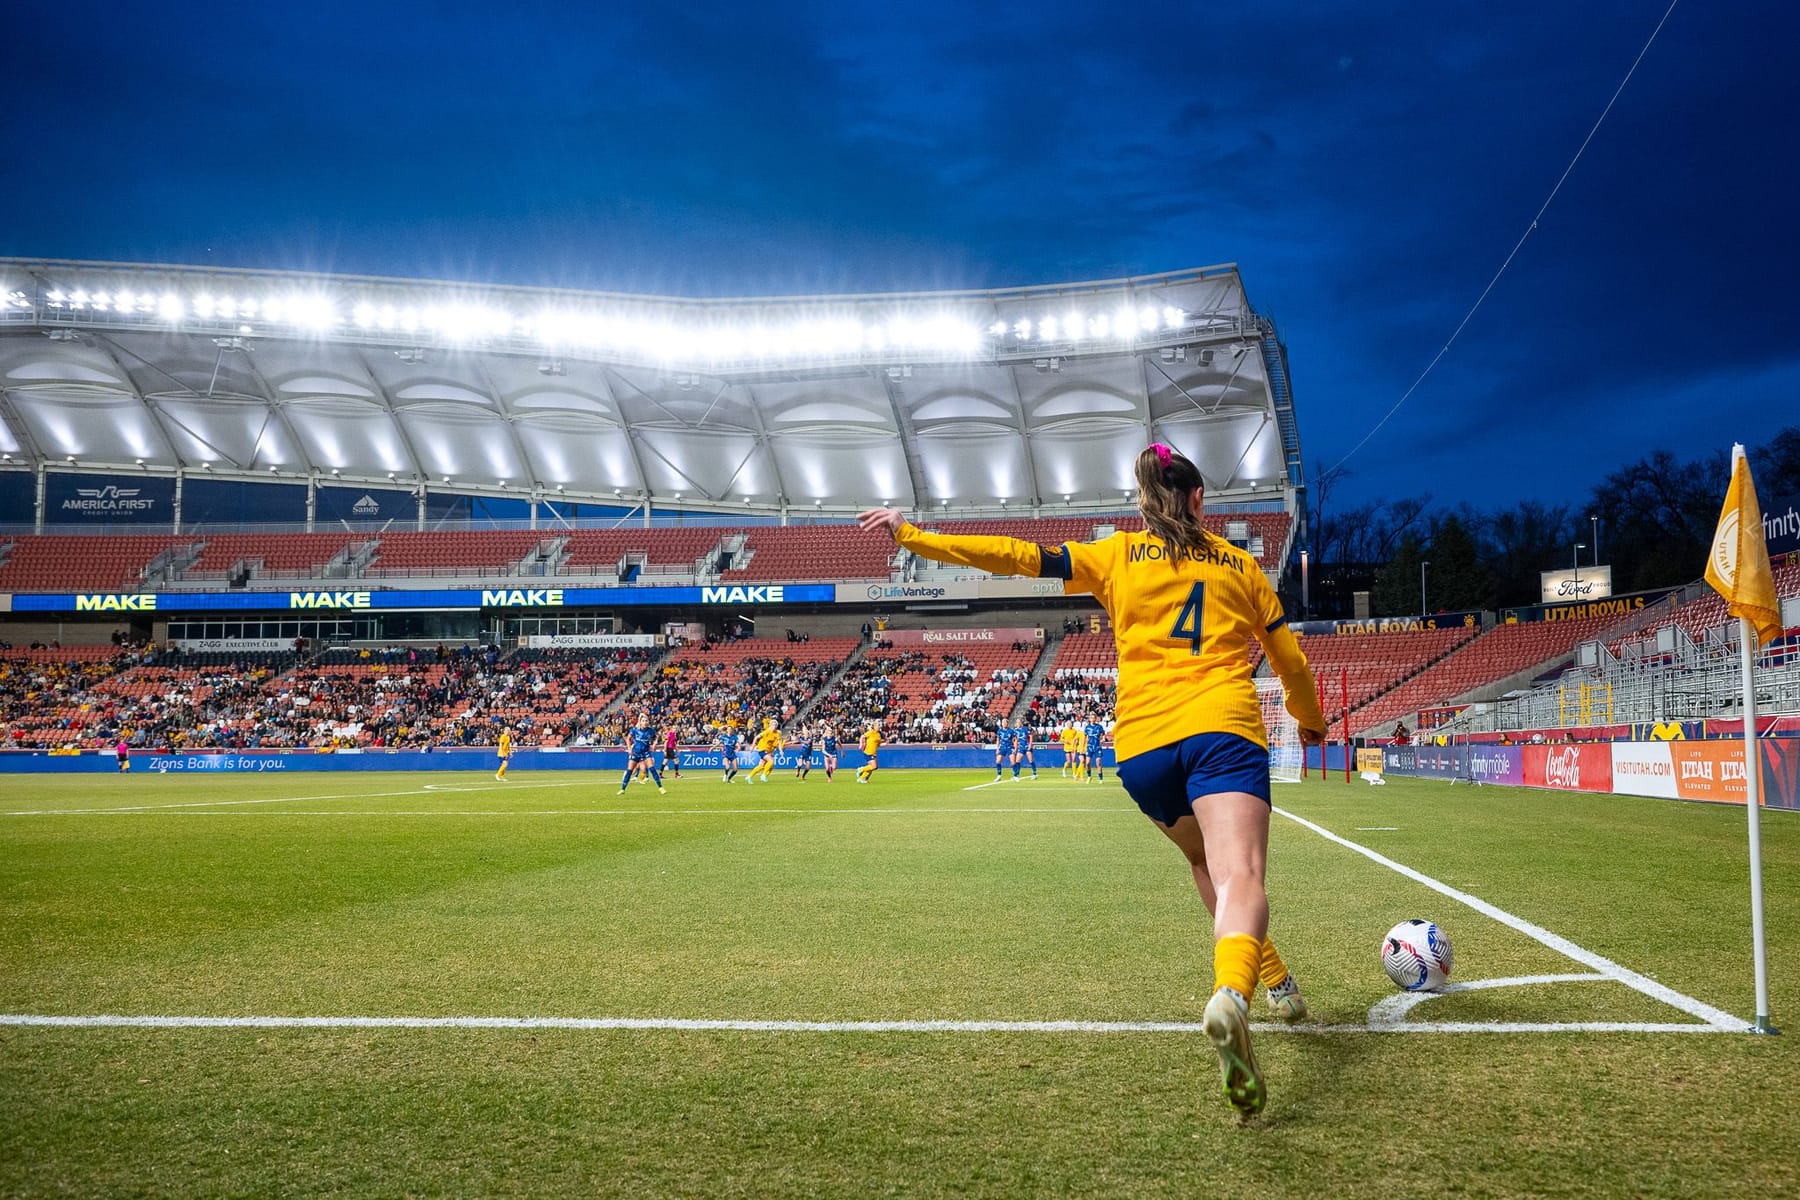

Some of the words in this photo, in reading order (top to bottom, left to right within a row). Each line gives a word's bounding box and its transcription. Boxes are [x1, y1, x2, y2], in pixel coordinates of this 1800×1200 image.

[62, 499, 117, 510] AMERICA
[118, 499, 155, 510] FIRST
[352, 505, 380, 516] Sandy
[1761, 506, 1800, 541] finity
[701, 586, 784, 604] MAKE
[883, 586, 945, 599] LifeVantage
[1557, 579, 1593, 597] Ford
[76, 594, 157, 611] MAKE
[290, 592, 371, 608] MAKE
[481, 589, 564, 607] MAKE
[1168, 579, 1206, 656] 4
[1544, 604, 1588, 622] UTAH
[1588, 597, 1646, 619] ROYALS
[1090, 618, 1101, 635] 5
[1336, 622, 1377, 636] UTAH
[1379, 619, 1437, 634] ROYALS
[550, 636, 574, 644] ZAGG
[945, 632, 968, 641] SALT
[969, 631, 995, 640] LAKE
[149, 757, 184, 769] Zions
[187, 757, 221, 769] Bank
[223, 757, 235, 769] is
[237, 756, 256, 769] for
[257, 759, 286, 772] you.
[683, 754, 719, 766] Zions
[773, 753, 792, 766] for
[1615, 760, 1671, 777] VISITUTAH.COM
[1680, 760, 1713, 781] UTAH
[1720, 760, 1748, 782] UTA
[1684, 782, 1711, 791] ELEVATED
[1724, 784, 1748, 793] ELEVAT
